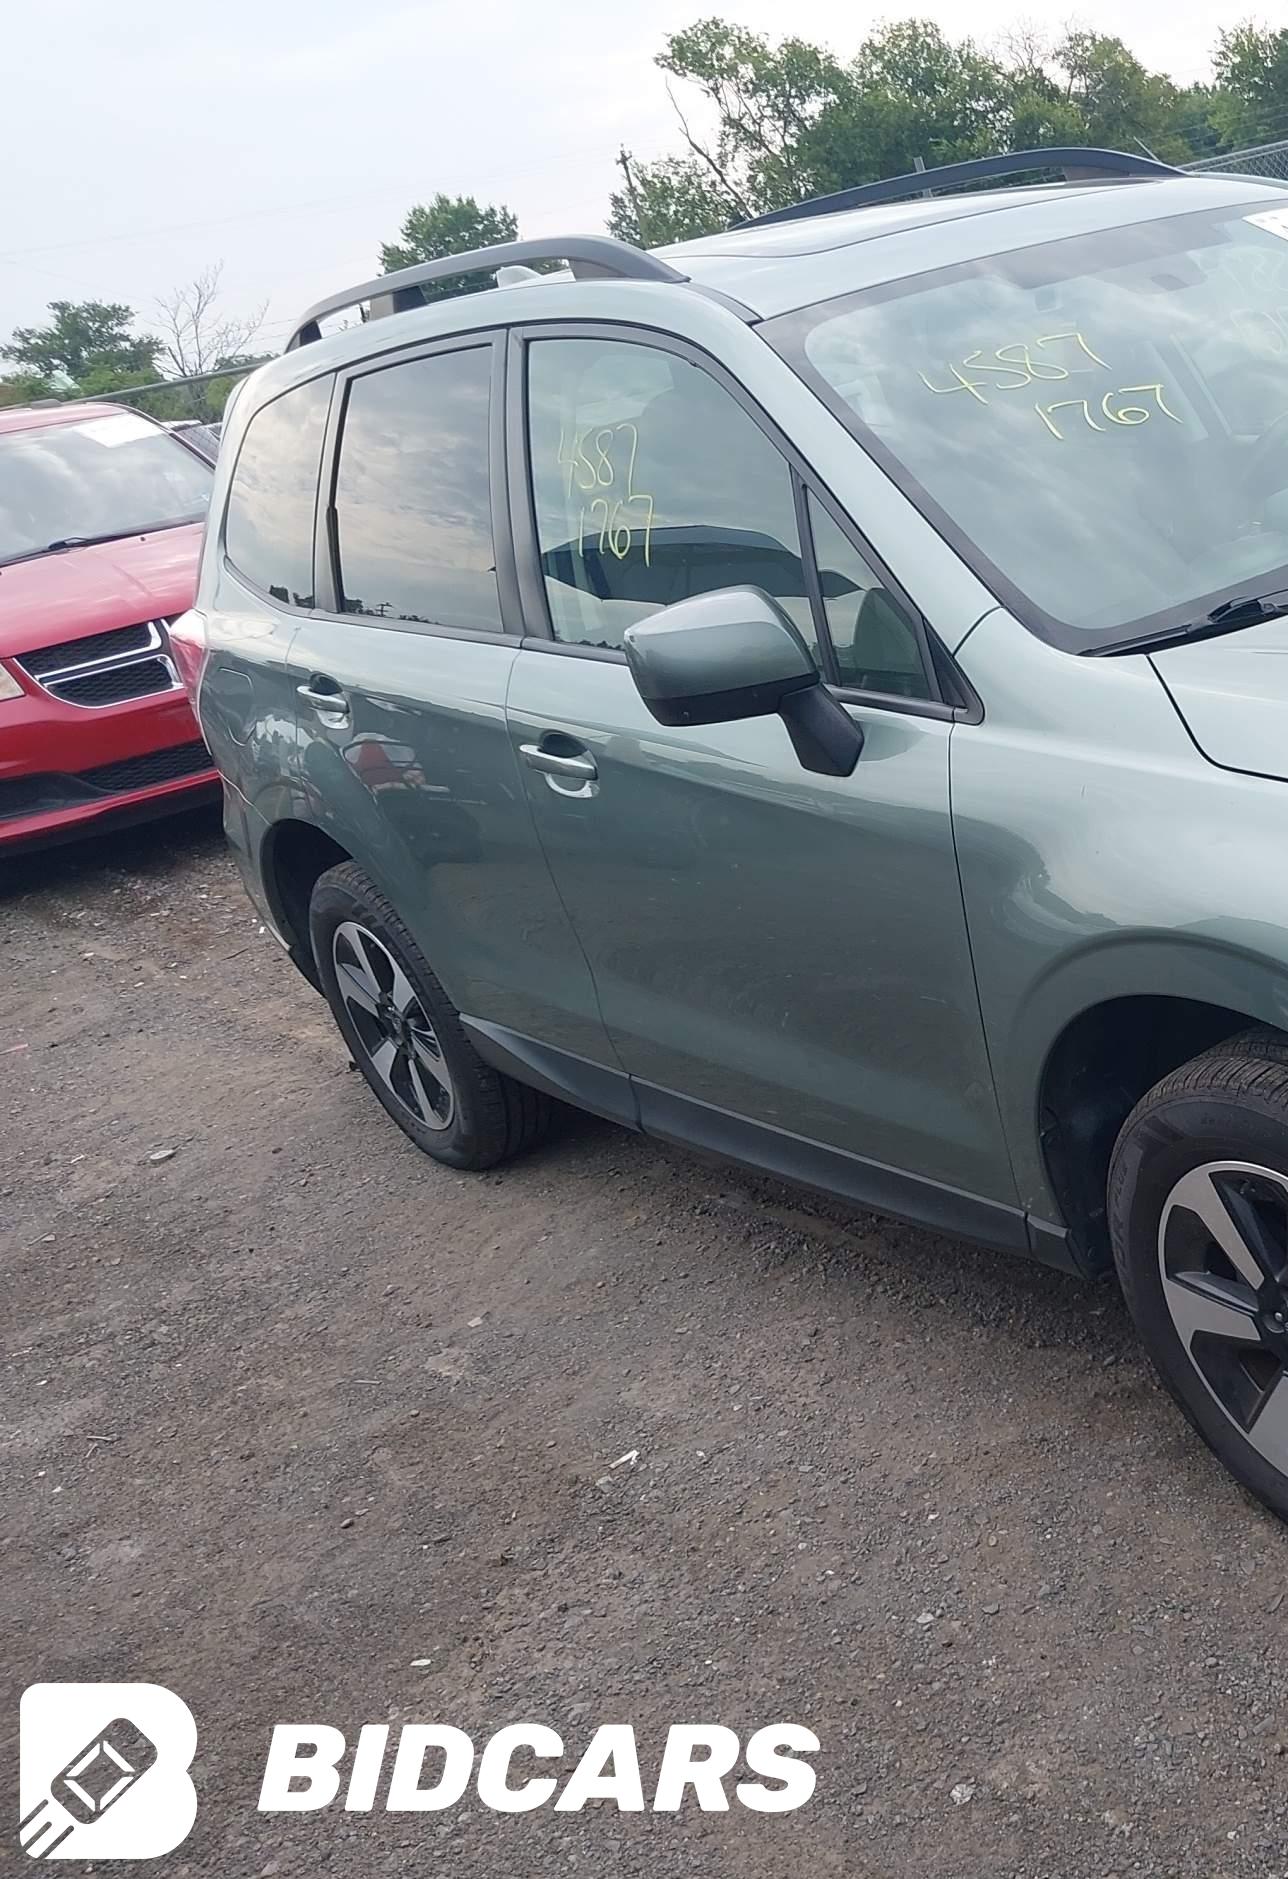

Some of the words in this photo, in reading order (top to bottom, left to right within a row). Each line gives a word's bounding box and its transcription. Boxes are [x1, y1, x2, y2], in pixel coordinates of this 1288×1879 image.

[917, 332, 1113, 405] 4587
[1034, 383, 1185, 440] 1767
[558, 423, 637, 498] 4587
[578, 494, 653, 568] 1767
